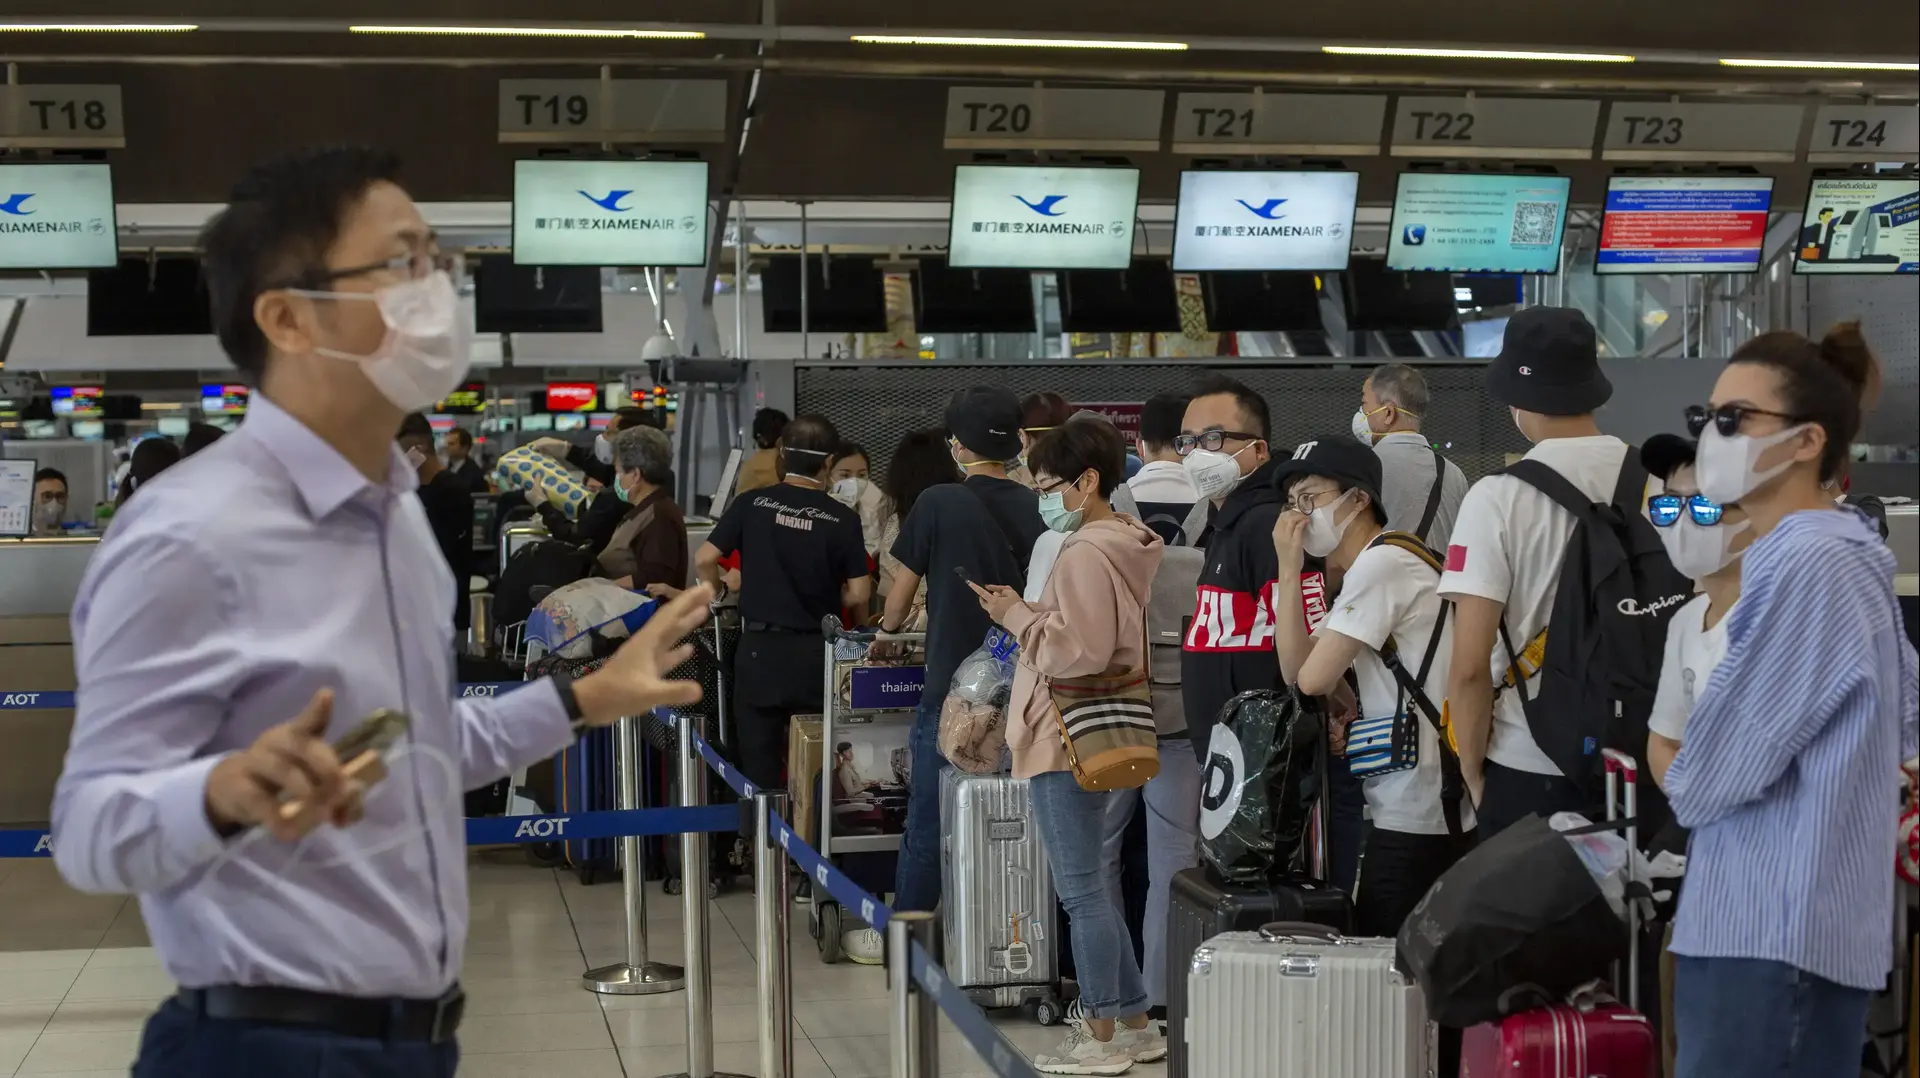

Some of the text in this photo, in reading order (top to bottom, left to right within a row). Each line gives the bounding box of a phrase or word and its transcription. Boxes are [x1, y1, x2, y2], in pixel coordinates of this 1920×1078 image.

[29, 100, 106, 130] T18
[515, 95, 588, 125] T19
[963, 103, 1031, 133] T20
[1192, 108, 1255, 137] T21
[1411, 112, 1474, 140] T22
[1623, 116, 1684, 144] T23
[1828, 119, 1887, 147] T24
[591, 219, 675, 230] XIAMENAIR
[1024, 222, 1105, 234] XIAMENAIR
[1246, 226, 1324, 237] XIAMENAIR
[753, 496, 840, 523] Bulletproof Edition
[775, 513, 813, 531] MMXIII
[1187, 589, 1276, 648] FILA
[3, 693, 40, 706] AOT
[463, 685, 498, 697] AOT
[880, 681, 925, 693] thaiairw
[514, 818, 571, 838] AOT
